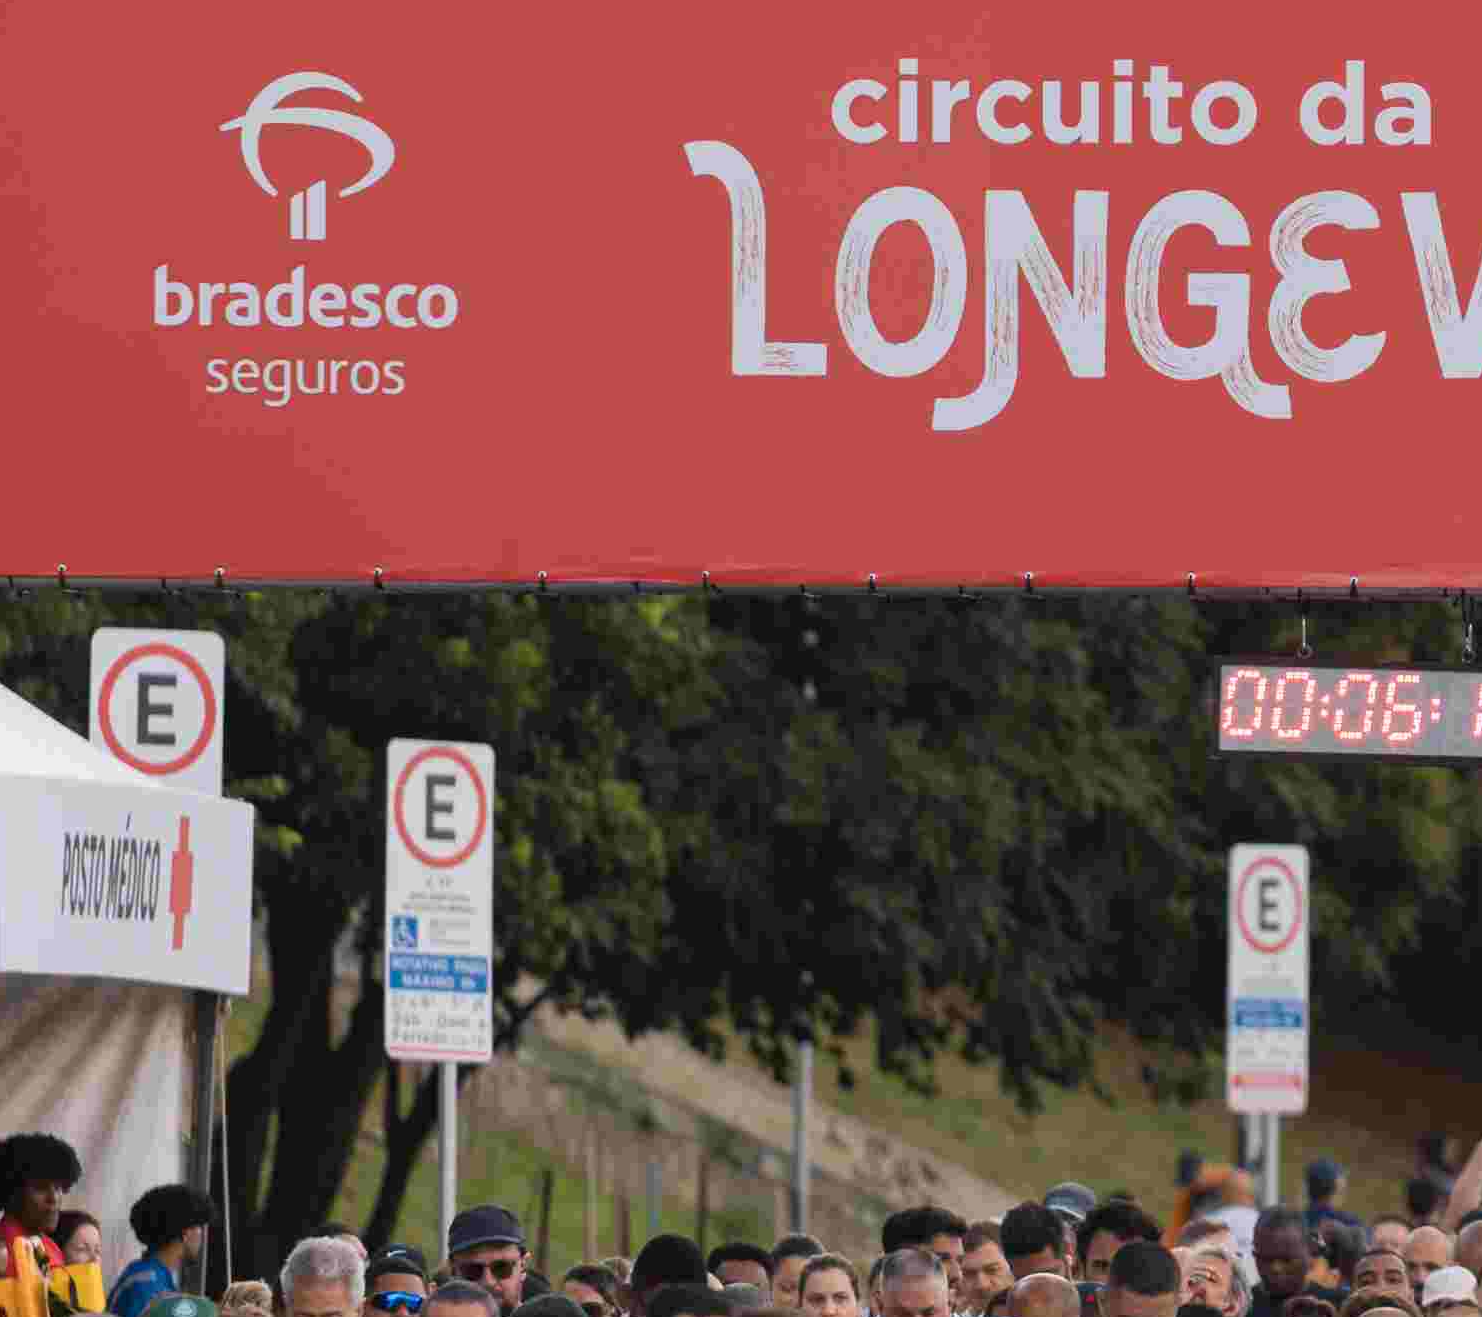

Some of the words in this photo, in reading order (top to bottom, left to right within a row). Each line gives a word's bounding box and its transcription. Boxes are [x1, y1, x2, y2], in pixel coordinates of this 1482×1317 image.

[831, 58, 1258, 146] circuito
[1299, 59, 1432, 146] da
[155, 264, 458, 329] bradesco
[205, 358, 405, 407] seguros
[137, 672, 178, 745] E
[425, 774, 457, 842] E
[61, 831, 106, 918] POSTO
[106, 812, 161, 921] MÉDICO
[1258, 879, 1281, 932] E
